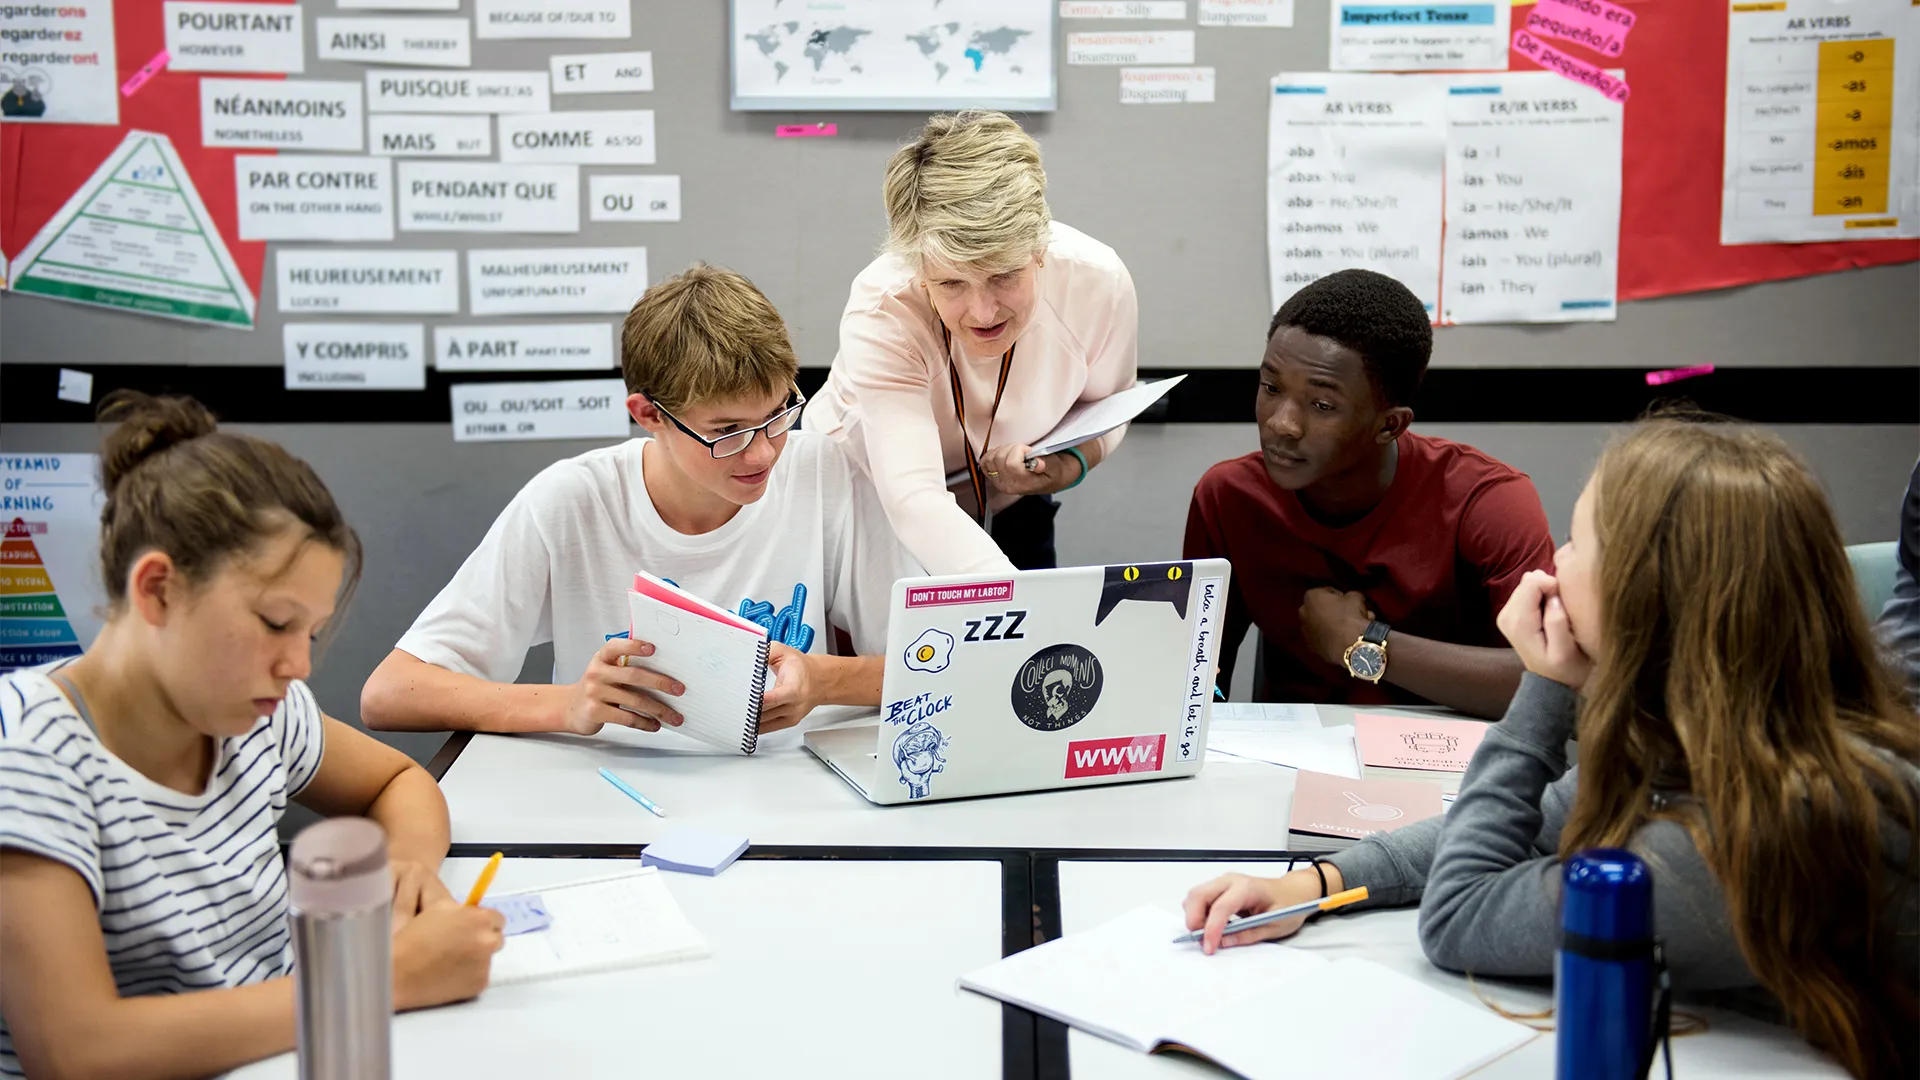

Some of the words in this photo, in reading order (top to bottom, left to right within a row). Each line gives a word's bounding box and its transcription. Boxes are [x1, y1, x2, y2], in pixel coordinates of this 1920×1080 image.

[179, 12, 294, 32] POURTANT
[489, 12, 543, 23] BECAUSE
[547, 12, 594, 23] OF/DUE
[599, 12, 616, 22] TO
[1343, 10, 1421, 24] Imperfect
[1425, 10, 1470, 22] Tense
[1787, 18, 1805, 30] AR
[1810, 16, 1851, 28] VERBS
[331, 32, 386, 50] AINSI
[402, 39, 458, 49] THEREBY
[179, 44, 244, 56] HOWEVER
[2, 51, 99, 67] regarderont
[564, 64, 586, 81] ET
[614, 67, 642, 79] AND
[381, 79, 471, 98] PUISQUE
[476, 85, 534, 98] SINCE/AS
[214, 94, 347, 119] NÉANMOINS
[1325, 102, 1344, 114] AR
[1350, 101, 1394, 114] VERBS
[1490, 101, 1529, 114] ER/IR
[1534, 99, 1578, 113] VERBS
[214, 129, 304, 142] NONETHELESS
[382, 134, 436, 151] MAIS
[456, 139, 481, 150] BUT
[512, 131, 593, 149] COMME
[604, 135, 642, 147] AS/SO
[249, 172, 290, 190] PAR
[296, 172, 379, 190] CONTRE
[1495, 171, 1523, 187] You
[412, 180, 509, 199] PENDANT
[515, 182, 557, 202] QUE
[250, 203, 270, 214] ON
[274, 203, 296, 214] THE
[300, 203, 347, 214] OTHER
[350, 203, 382, 214] HAND
[603, 195, 634, 212] OU
[650, 200, 668, 211] OR
[1498, 198, 1572, 215] He/She/It
[412, 211, 503, 224] WHILE/WHILST
[1524, 225, 1549, 240] We
[1515, 253, 1543, 268] You
[1547, 249, 1602, 269] (plural)
[290, 268, 443, 285] HEUREUSEMENT
[480, 262, 630, 278] MALHEUREUSEMENT
[482, 285, 586, 299] UNFORTUNATELY
[1499, 278, 1538, 297] They
[296, 342, 308, 360] Y
[314, 341, 409, 361] COMPRIS
[447, 335, 462, 358] À
[467, 340, 519, 358] PART
[298, 372, 366, 384] INCLUDING
[4, 477, 22, 491] OF
[15, 576, 48, 588] VISUAL
[912, 590, 936, 603] DON'T
[937, 589, 962, 601] TOUCH
[963, 588, 977, 598] MY
[978, 586, 1008, 598] LABTOP
[1202, 584, 1215, 613] take
[1199, 617, 1209, 627] a
[20, 652, 32, 663] BY
[1193, 631, 1210, 672] breath
[1189, 675, 1204, 701] and
[885, 692, 933, 723] BEAT
[891, 713, 907, 726] THE
[906, 695, 953, 725] CLOCK
[1187, 704, 1202, 722] let
[1022, 714, 1041, 728] NOT
[1047, 710, 1087, 729] THINGS
[1184, 725, 1198, 738] it
[1179, 742, 1191, 759] go
